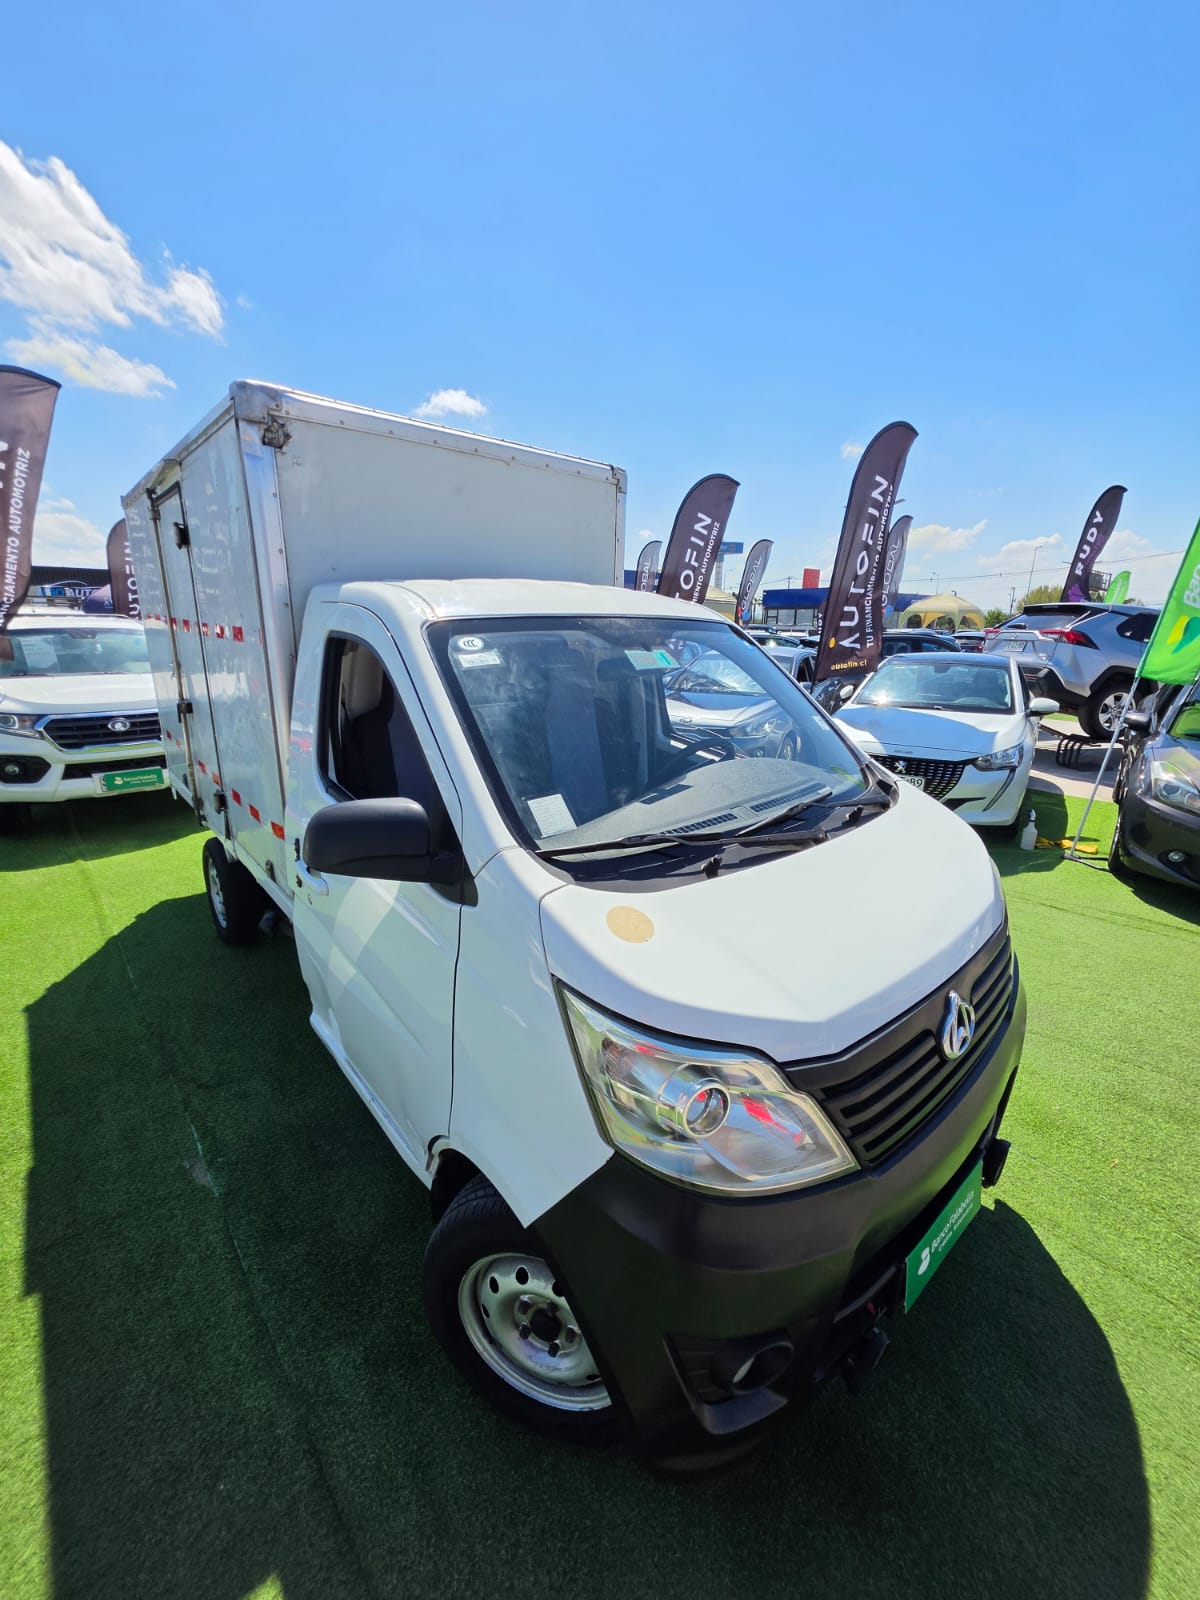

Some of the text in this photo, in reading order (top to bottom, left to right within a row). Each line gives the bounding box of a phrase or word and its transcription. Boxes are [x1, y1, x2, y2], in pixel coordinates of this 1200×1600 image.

[10, 447, 30, 537] AUTOMOTRIZ
[702, 521, 721, 574] AUTOMOTRIZ
[838, 475, 889, 650] AUTOFIN
[881, 537, 900, 606] GLOBAL
[1075, 510, 1104, 576] RUDY
[741, 556, 762, 609] GLOBAL
[830, 659, 867, 671] autofin.cl
[866, 635, 874, 649] TU
